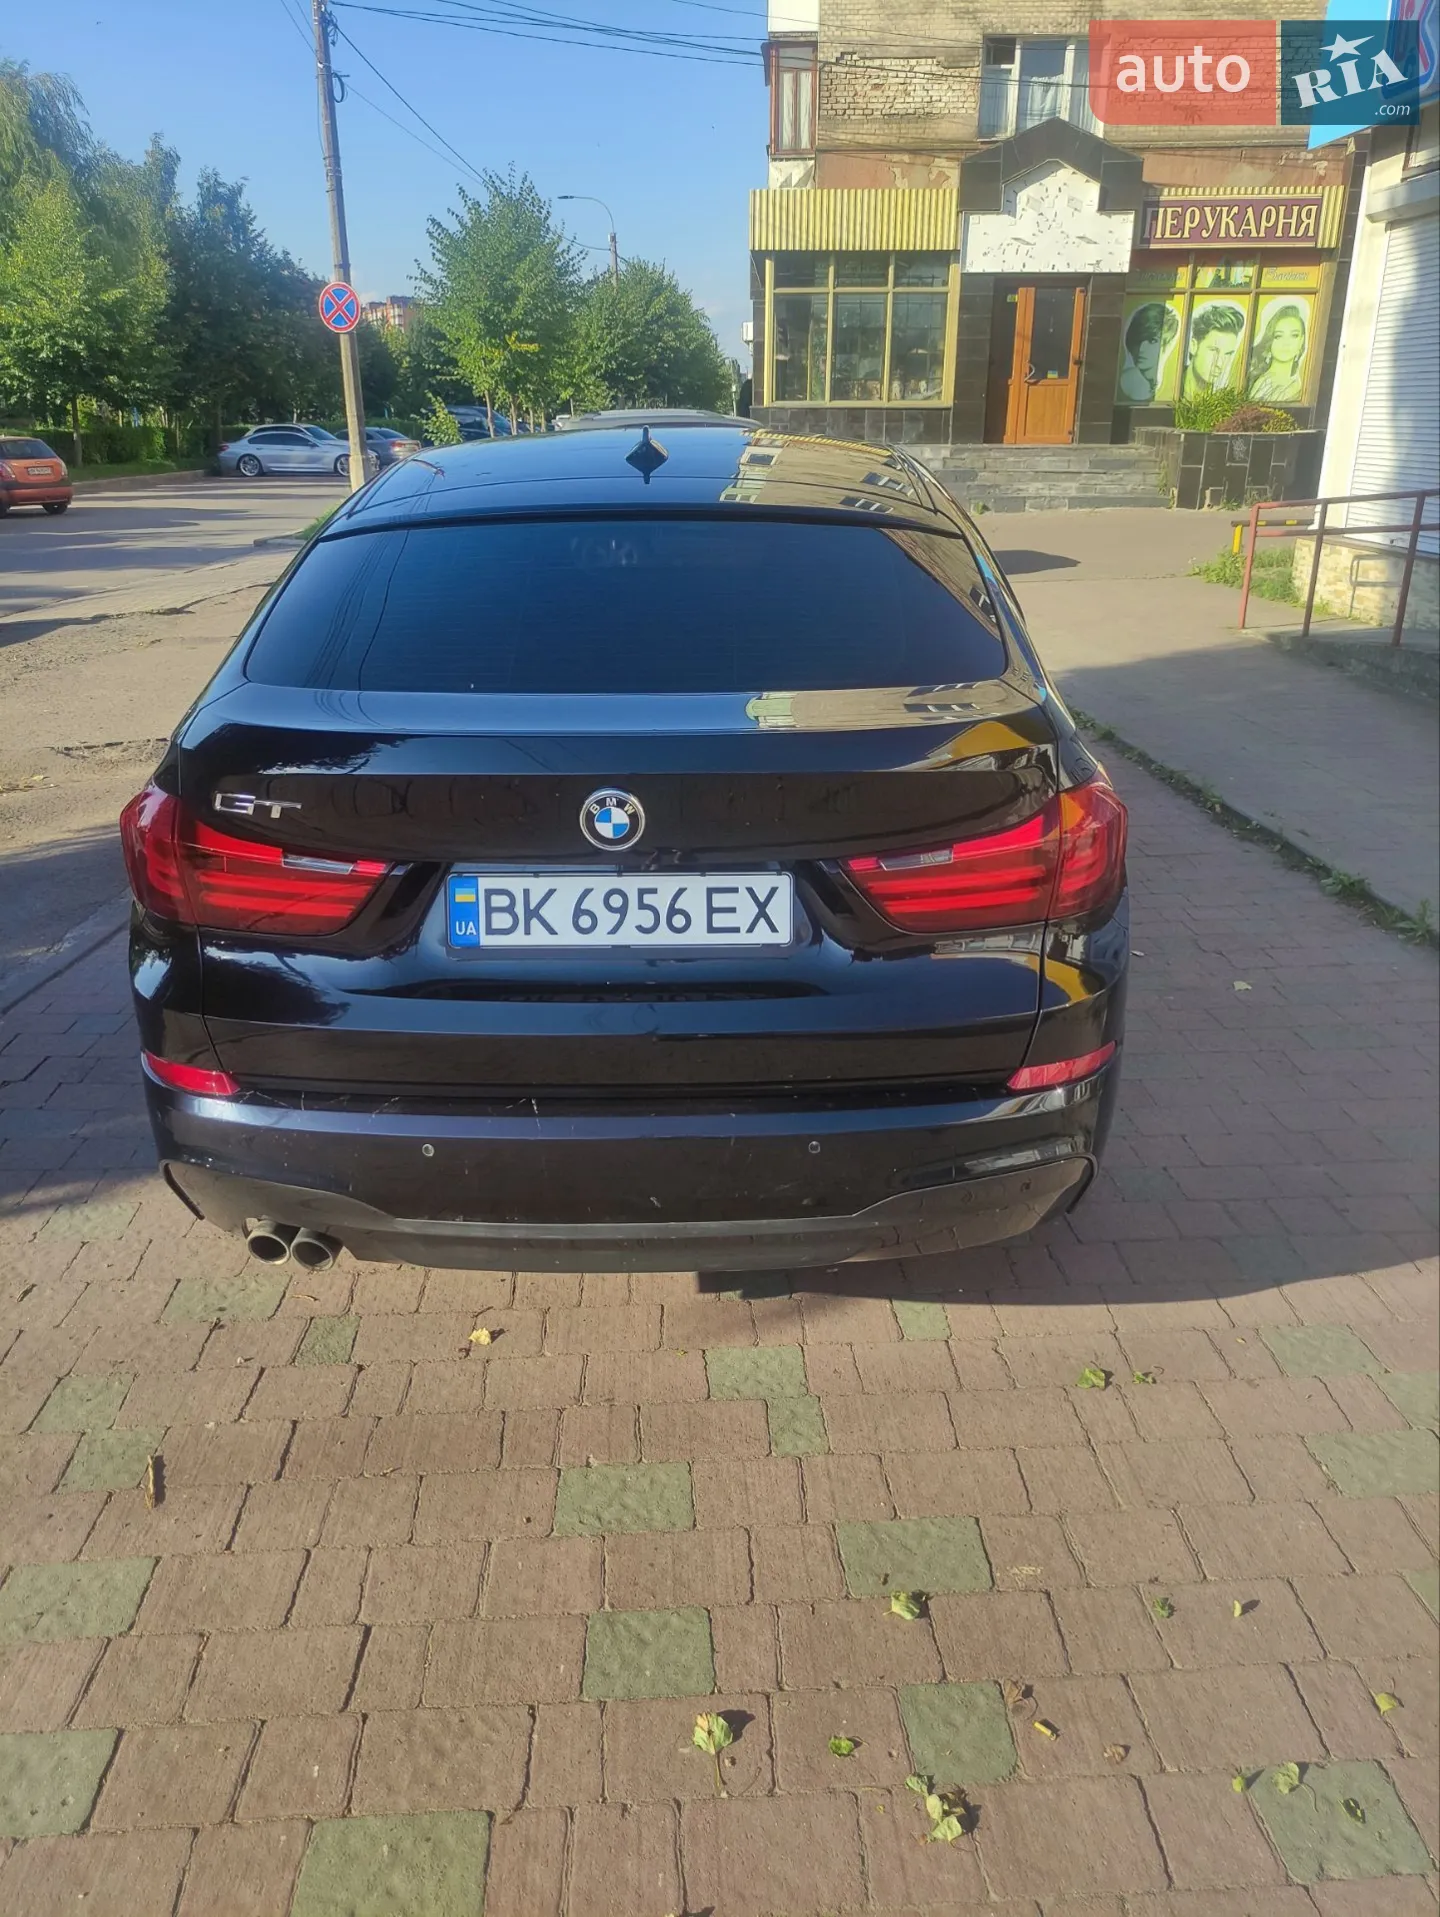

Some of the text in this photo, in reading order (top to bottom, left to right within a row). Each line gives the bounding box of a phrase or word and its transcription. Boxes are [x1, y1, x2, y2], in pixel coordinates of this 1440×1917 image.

[1142, 204, 1319, 240] ПЕРУКАРНЯ
[214, 792, 303, 819] GT
[589, 797, 636, 815] BMW
[483, 886, 780, 936] BK 6956 EX
[455, 921, 477, 936] UA
